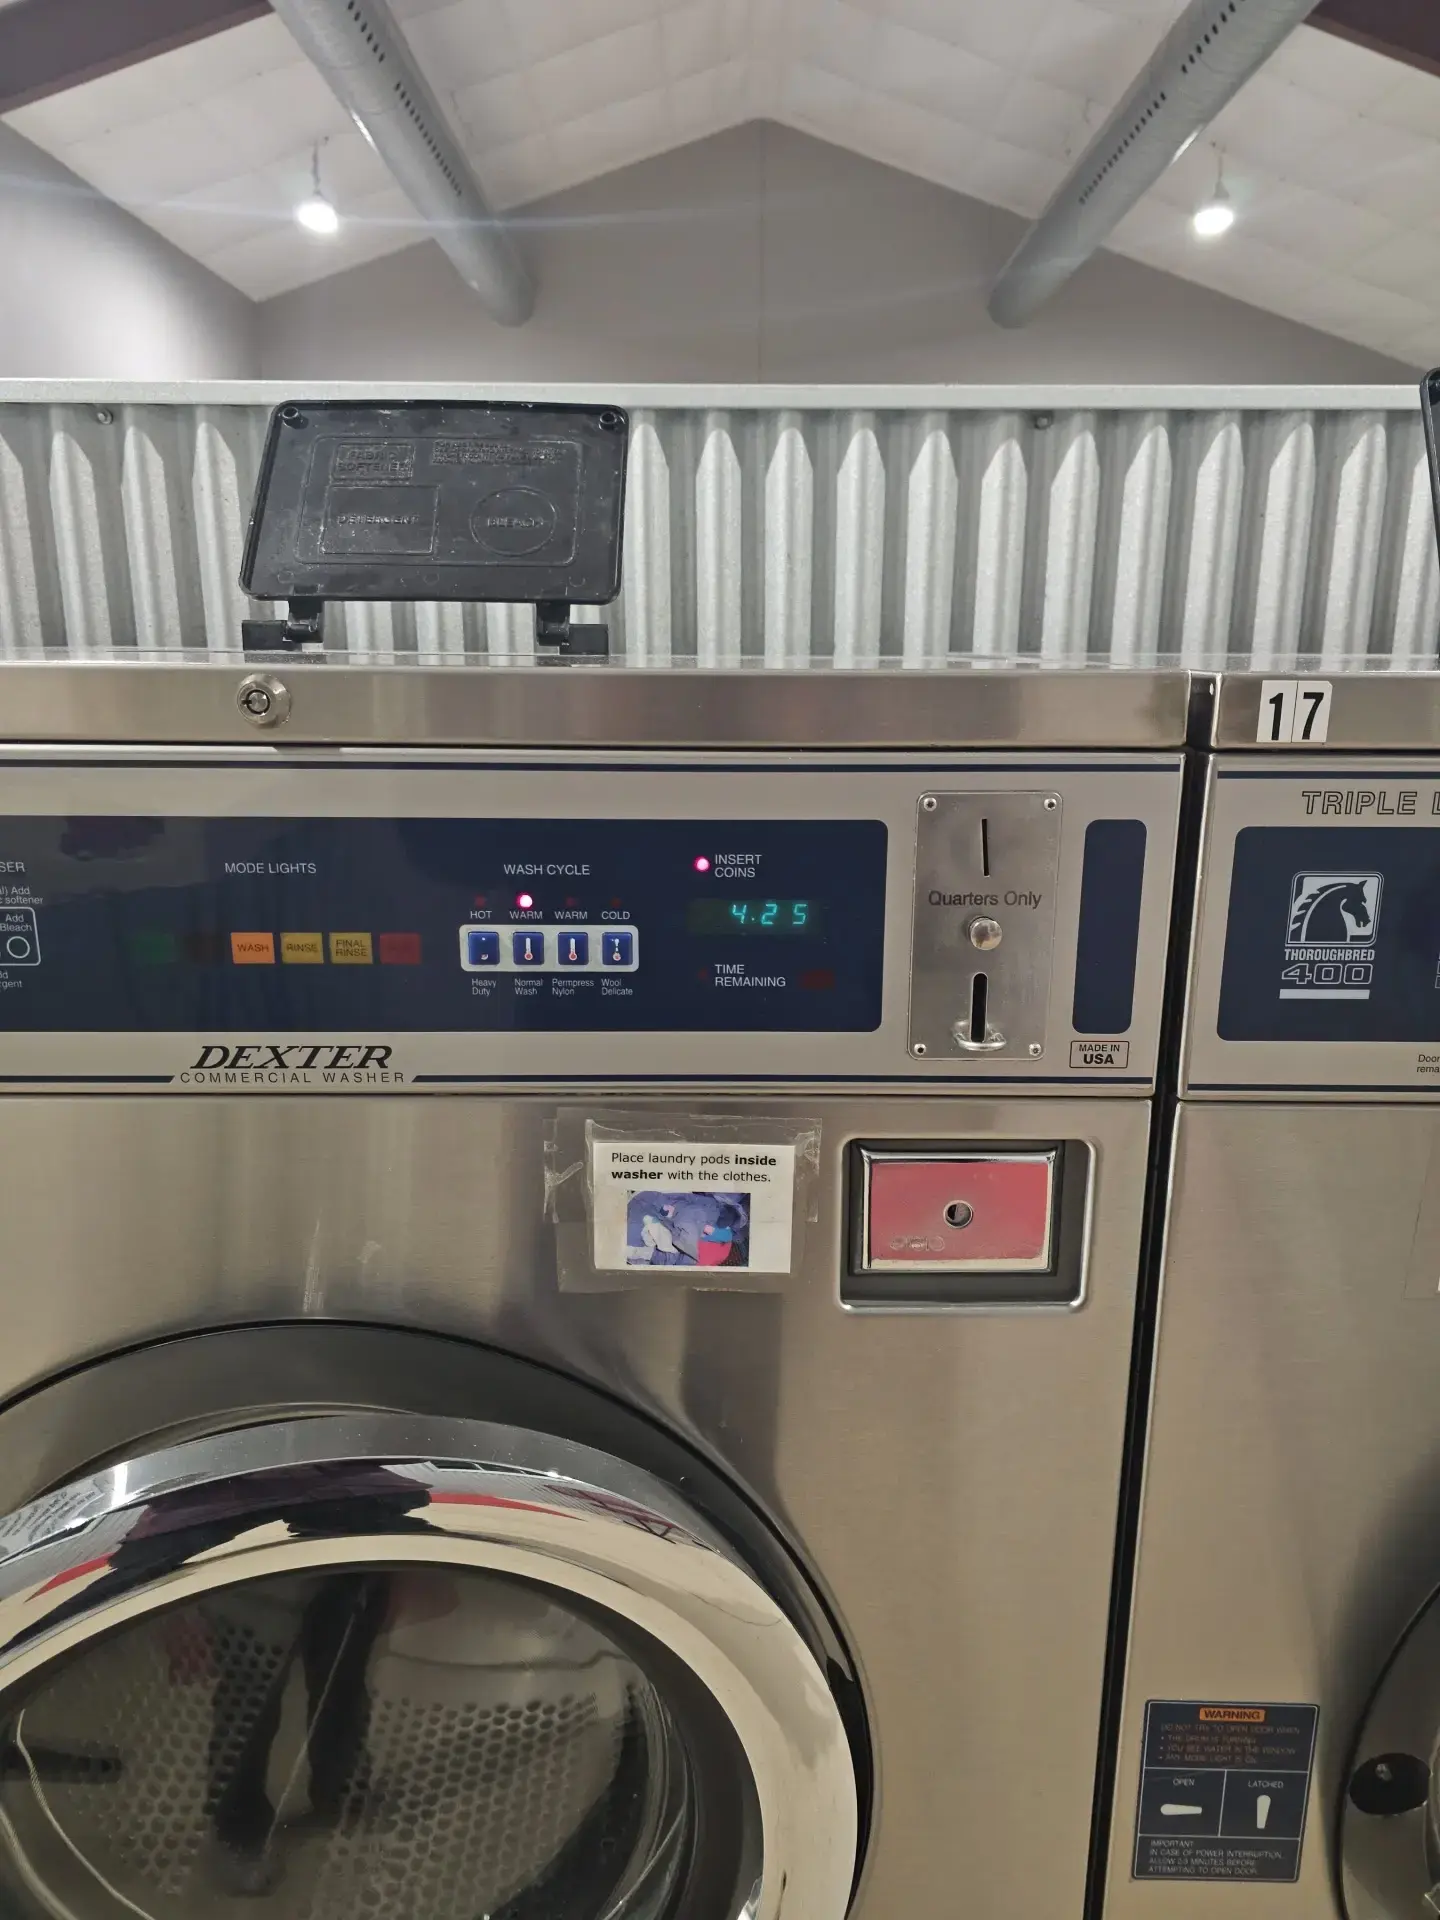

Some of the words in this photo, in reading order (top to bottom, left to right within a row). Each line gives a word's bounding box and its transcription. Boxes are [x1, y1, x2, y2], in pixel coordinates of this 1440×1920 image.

[1268, 692, 1325, 741] 17
[1302, 791, 1418, 816] TRIPLE
[714, 854, 763, 865] INSERT
[224, 862, 265, 874] MODE
[268, 862, 317, 874] LIGHTS
[503, 864, 543, 875] WASH
[546, 864, 591, 876] CYCLE
[714, 867, 756, 878] COINS
[11, 886, 31, 895] Add
[928, 890, 999, 906] Quarters
[1003, 890, 1042, 910] Only
[5, 913, 24, 922] Add
[470, 910, 493, 920] HOT
[509, 910, 543, 920] WARM
[554, 911, 588, 920] WARM
[601, 911, 631, 920] COLD
[731, 903, 808, 925] 4.25
[0, 923, 33, 932] Bleach
[237, 943, 270, 953] WASH
[286, 943, 319, 954] RINSE
[336, 939, 366, 948] FINAL
[335, 948, 368, 957] RINSE
[1284, 948, 1376, 961] THOROUGHBRED
[714, 964, 745, 974] TIME
[1281, 963, 1374, 985] 400
[471, 978, 497, 989] Heavy
[514, 978, 543, 987] Normal
[552, 978, 595, 989] Permpress
[601, 978, 622, 987] Wool
[714, 976, 787, 987] REMAINING
[472, 987, 491, 997] Duty
[514, 987, 538, 995] Wash
[552, 987, 575, 997] Nylon
[601, 987, 633, 996] Delicate
[1079, 1044, 1108, 1052] MADE
[1110, 1044, 1120, 1052] IN
[189, 1045, 393, 1069] DEXTER
[1083, 1054, 1114, 1064] USA
[1418, 1054, 1440, 1063] Door
[180, 1072, 312, 1083] COMMERCIAL
[322, 1072, 405, 1083] WASHER
[611, 1152, 644, 1163] Place
[648, 1153, 696, 1165] laundry
[700, 1154, 731, 1165] pods
[734, 1155, 777, 1166] inside
[611, 1170, 663, 1180] washer
[667, 1170, 694, 1180] with
[698, 1170, 719, 1181] the
[723, 1171, 771, 1182] clothes.
[1204, 1710, 1261, 1720] WARNING
[1173, 1778, 1195, 1787] OPEN
[1248, 1780, 1284, 1789] LATCHED
